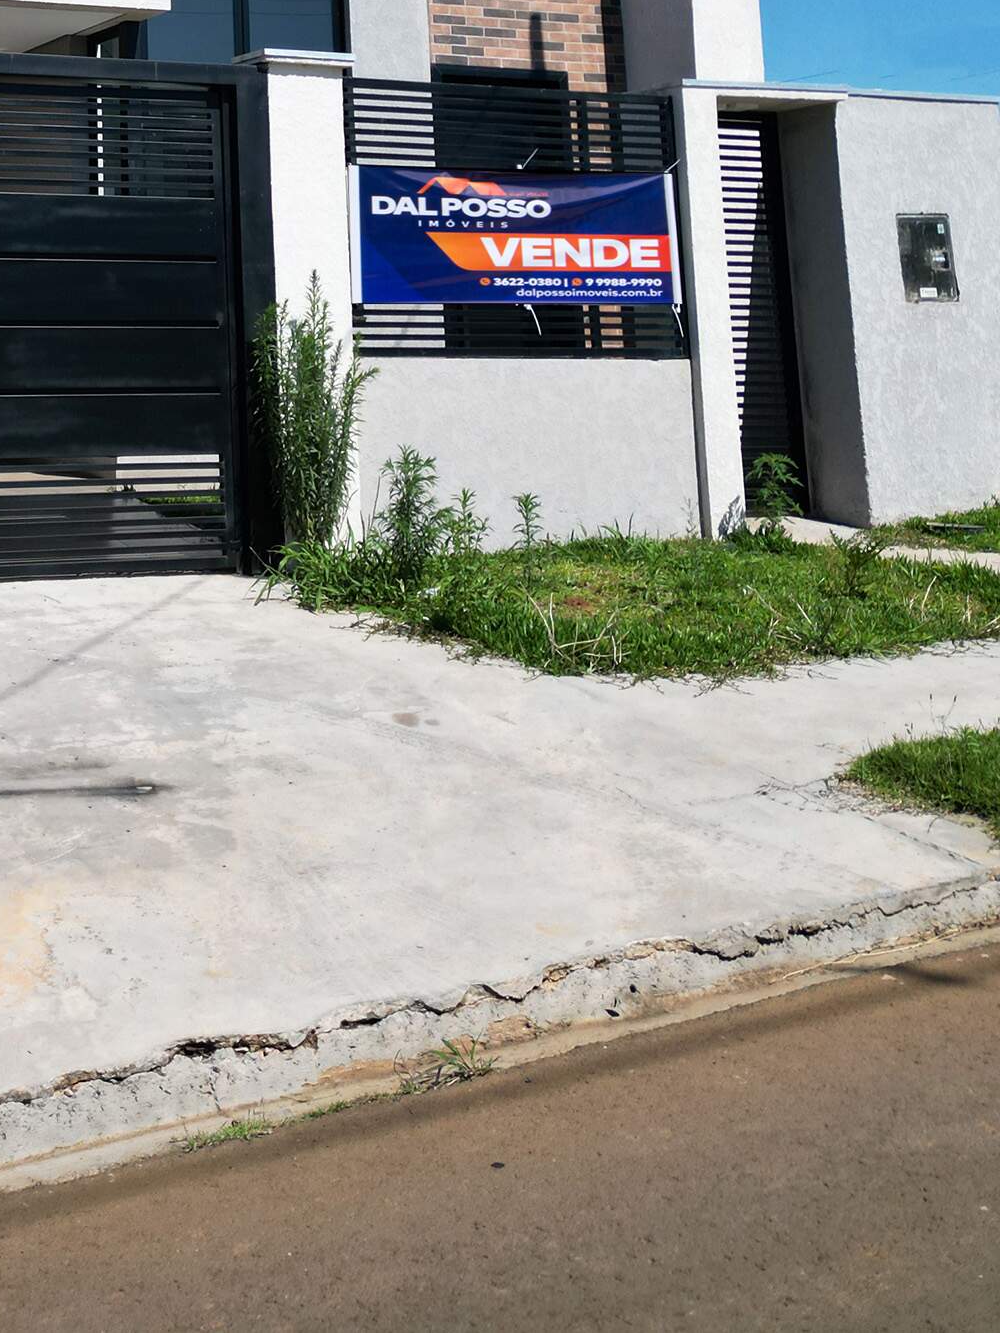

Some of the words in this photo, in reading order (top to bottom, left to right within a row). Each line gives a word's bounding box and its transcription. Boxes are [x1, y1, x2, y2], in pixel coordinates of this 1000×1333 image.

[371, 195, 438, 216] DAL
[441, 199, 552, 218] POSSO
[417, 219, 509, 229] IMÓVEIS
[480, 237, 661, 268] VENDE
[493, 277, 562, 287] 3622-0380
[595, 278, 663, 287] 9988-9990
[516, 287, 663, 298] dalpossoimoveis.com.br
